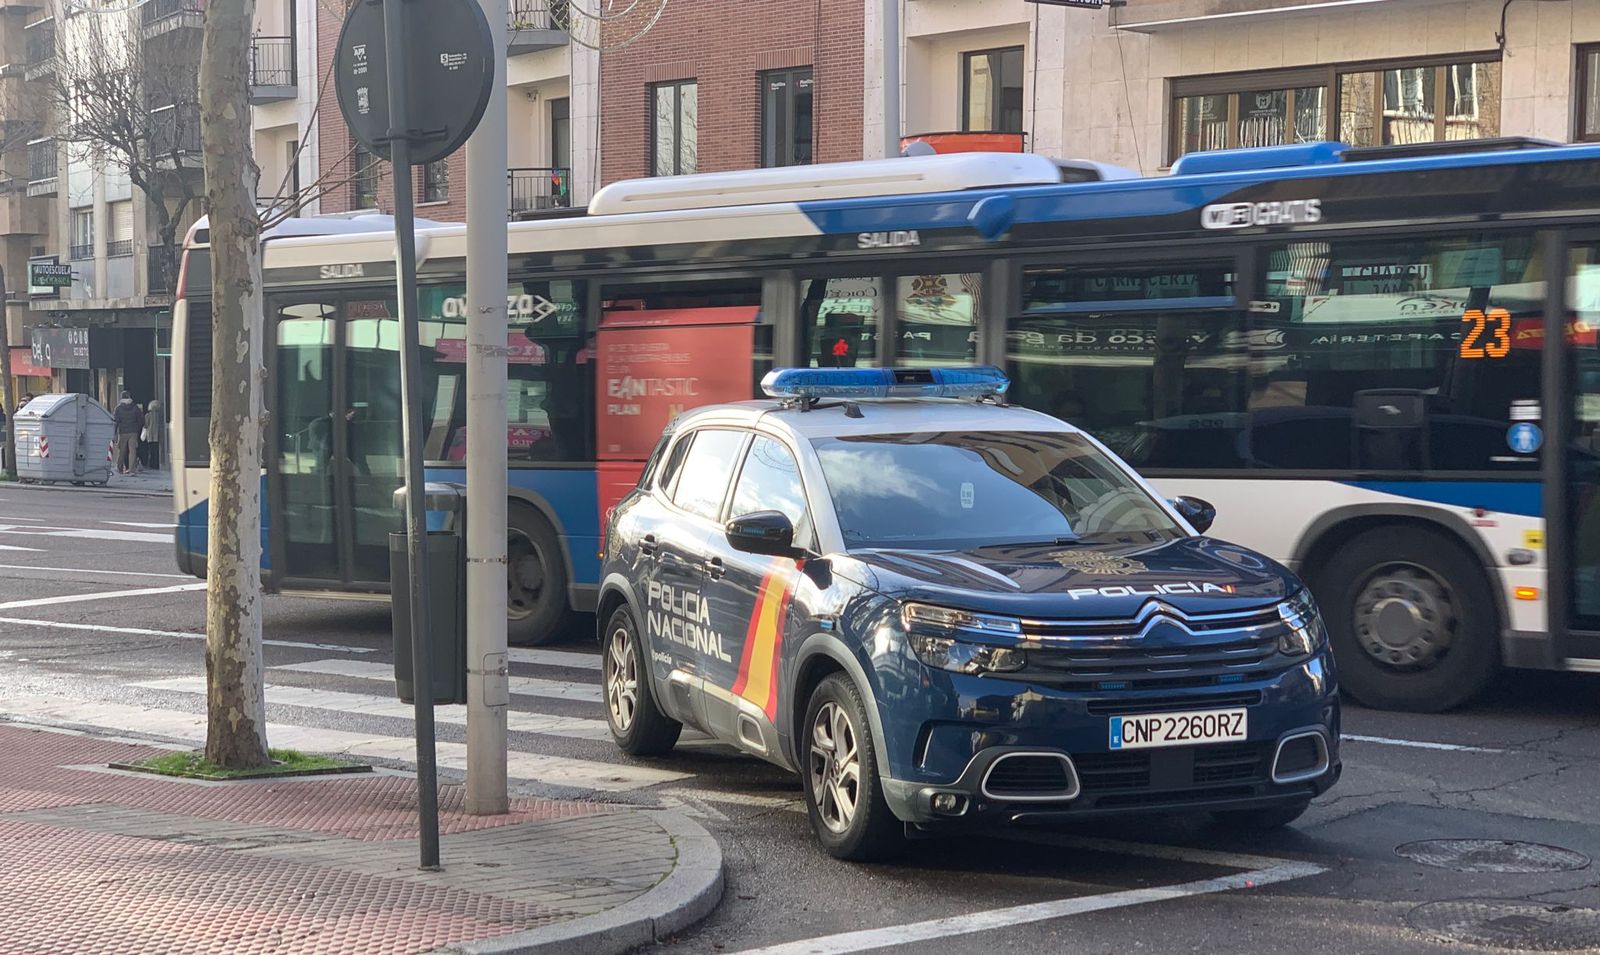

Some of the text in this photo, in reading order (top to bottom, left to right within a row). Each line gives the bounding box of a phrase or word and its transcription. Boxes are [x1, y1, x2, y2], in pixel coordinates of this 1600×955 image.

[857, 230, 920, 248] SALIDA
[319, 264, 364, 279] SALIDA
[1460, 308, 1512, 359] 23
[607, 404, 641, 415] PLAN
[647, 609, 732, 663] NACIONAL
[1122, 713, 1244, 744] CNP2260RZ
[1113, 735, 1120, 744] E
